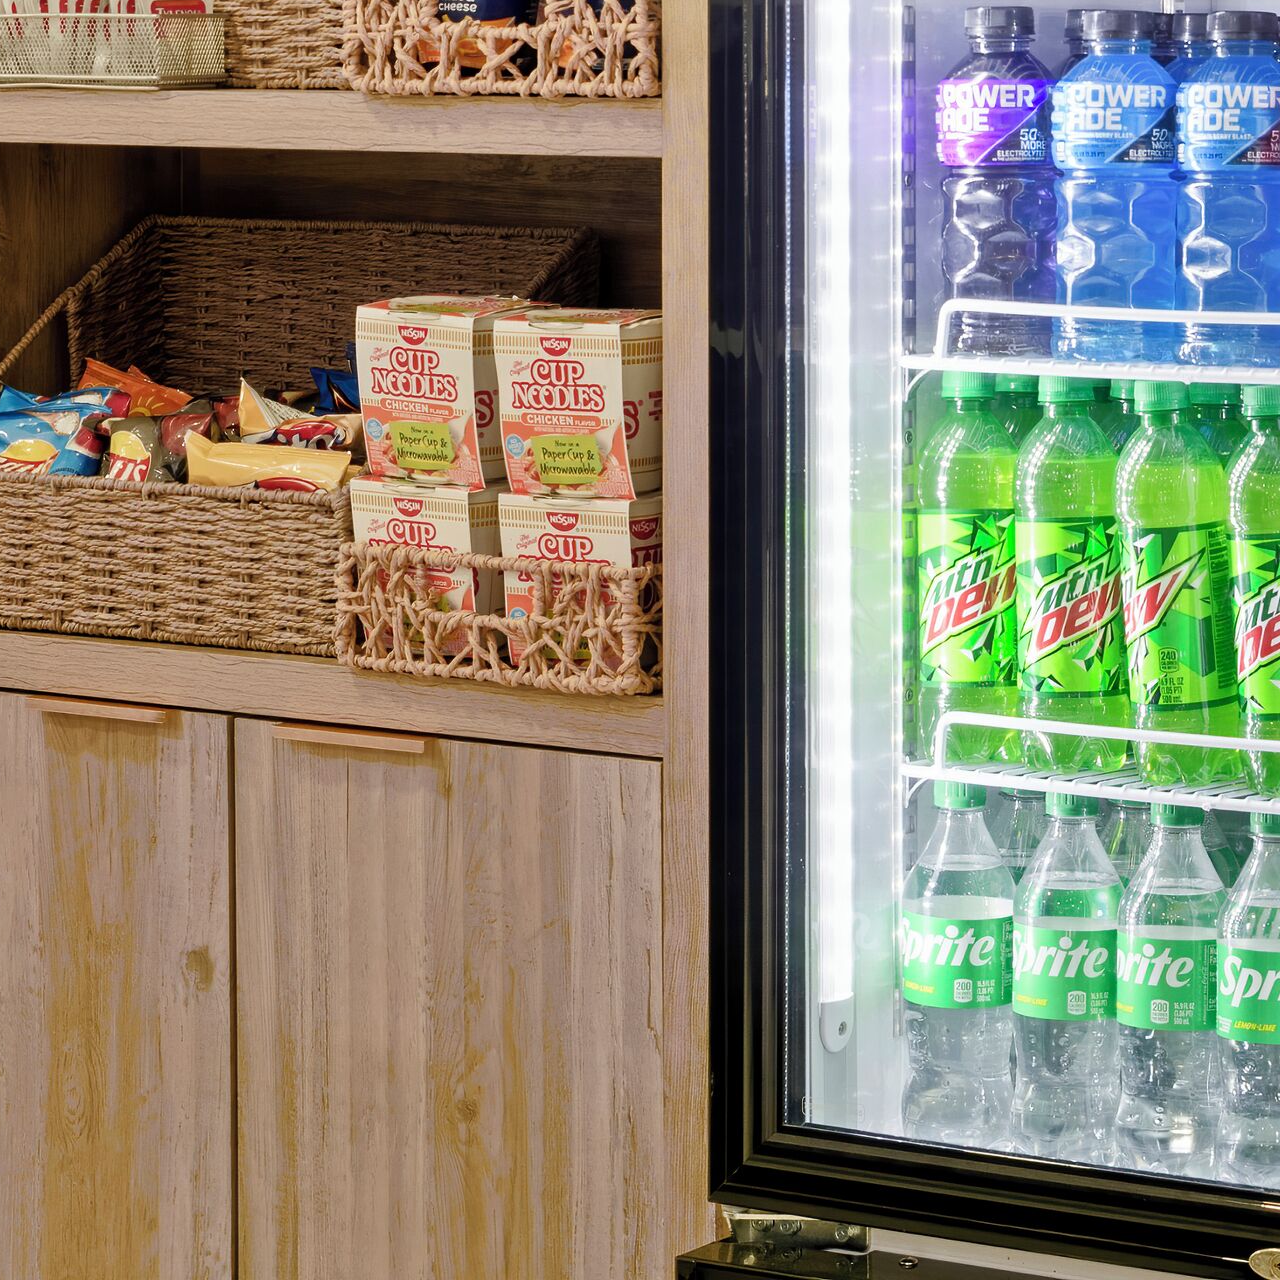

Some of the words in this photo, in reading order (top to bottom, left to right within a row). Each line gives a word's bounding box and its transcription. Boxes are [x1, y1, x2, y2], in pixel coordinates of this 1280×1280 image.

[942, 84, 1036, 109] POWER
[1069, 83, 1167, 108] POWER
[942, 107, 990, 132] ADE
[1069, 107, 1123, 131] ADE
[1187, 107, 1240, 132] ADE
[1019, 140, 1047, 150] MORE
[400, 328, 426, 340] NISSIN
[543, 339, 569, 351] NISSIN
[390, 346, 440, 375] CUP
[531, 359, 585, 386] CUP
[371, 367, 458, 403] NOODLES
[512, 381, 605, 413] NOODLES
[385, 400, 429, 414] CHICKEN
[527, 414, 574, 426] CHICKEN
[399, 432, 421, 447] Paper
[422, 435, 439, 450] Cup
[440, 439, 448, 448] &
[396, 447, 449, 463] Microwavable
[542, 447, 566, 461] Paper
[567, 448, 585, 462] Cup
[586, 450, 595, 461] &
[540, 463, 597, 476] Microwavable
[396, 498, 422, 511] NISSIN
[549, 513, 577, 525] NISSIN
[387, 518, 436, 545] CUP
[538, 533, 593, 560] CUP
[1160, 650, 1177, 662] 240
[955, 981, 972, 992] 200
[1069, 994, 1085, 1004] 200
[1152, 1001, 1168, 1013] 200
[1234, 1020, 1277, 1032] LEMON-LIME
